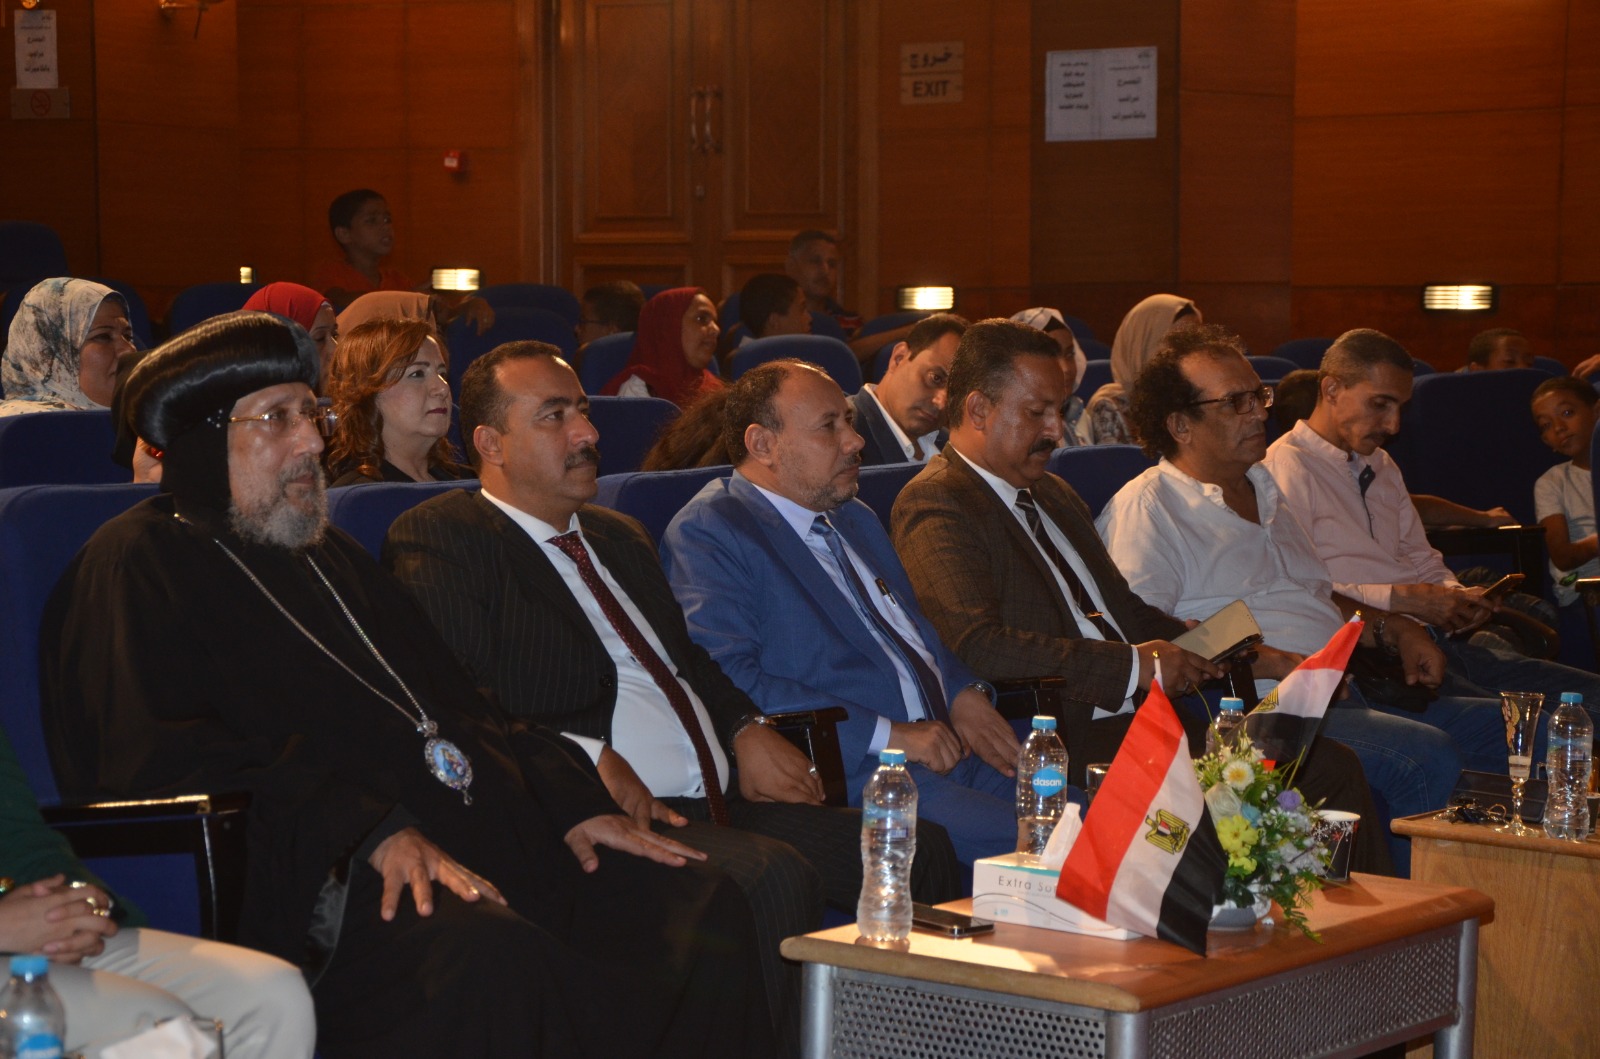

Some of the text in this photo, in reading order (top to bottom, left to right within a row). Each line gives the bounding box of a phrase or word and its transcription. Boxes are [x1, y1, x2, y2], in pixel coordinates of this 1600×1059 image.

[912, 80, 950, 98] EXIT
[1032, 777, 1062, 787] dasani
[998, 875, 1031, 890] Extra
